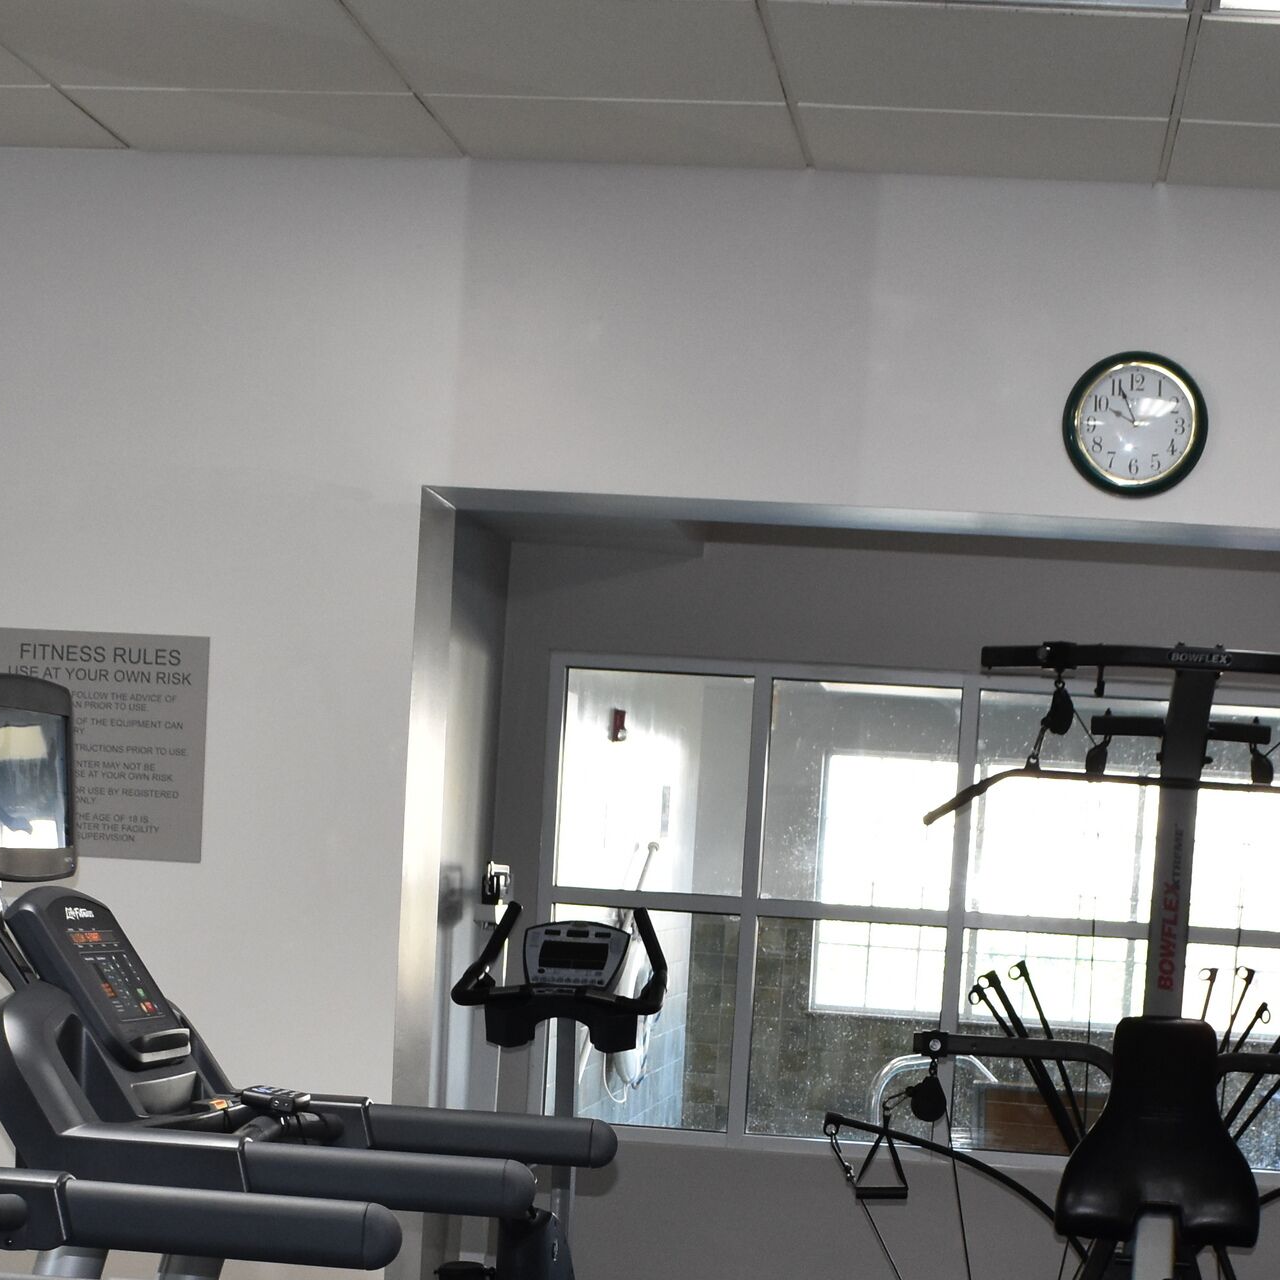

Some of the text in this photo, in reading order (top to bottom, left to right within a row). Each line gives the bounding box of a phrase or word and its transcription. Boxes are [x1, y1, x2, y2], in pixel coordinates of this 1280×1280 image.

[1111, 378, 1122, 396] 11
[1130, 373, 1145, 392] 12
[1157, 379, 1162, 397] 1
[1094, 395, 1109, 412] 10
[1086, 415, 1097, 433] 9
[1174, 417, 1185, 435] 3
[1091, 436, 1103, 454] 8
[1167, 438, 1178, 456] 4
[1107, 451, 1117, 469] 7
[1128, 458, 1139, 475] 6
[1151, 453, 1161, 471] 5
[20, 643, 182, 666] FITNESS RULES
[1171, 652, 1227, 664] BOWFLEX
[43, 667, 60, 680] AT
[65, 667, 109, 683] YOUR
[113, 669, 151, 684] OWN
[155, 670, 193, 686] RISK
[84, 701, 112, 711] PRIOR
[114, 703, 127, 711] TO
[111, 692, 128, 701] THE
[129, 693, 162, 703] ADVICE
[91, 718, 109, 727] THE
[110, 719, 162, 729] EQUIPMENT
[74, 743, 124, 753] TRUCTIONS
[122, 788, 180, 800] REGISTERED
[1157, 881, 1181, 992] BOWFLEX
